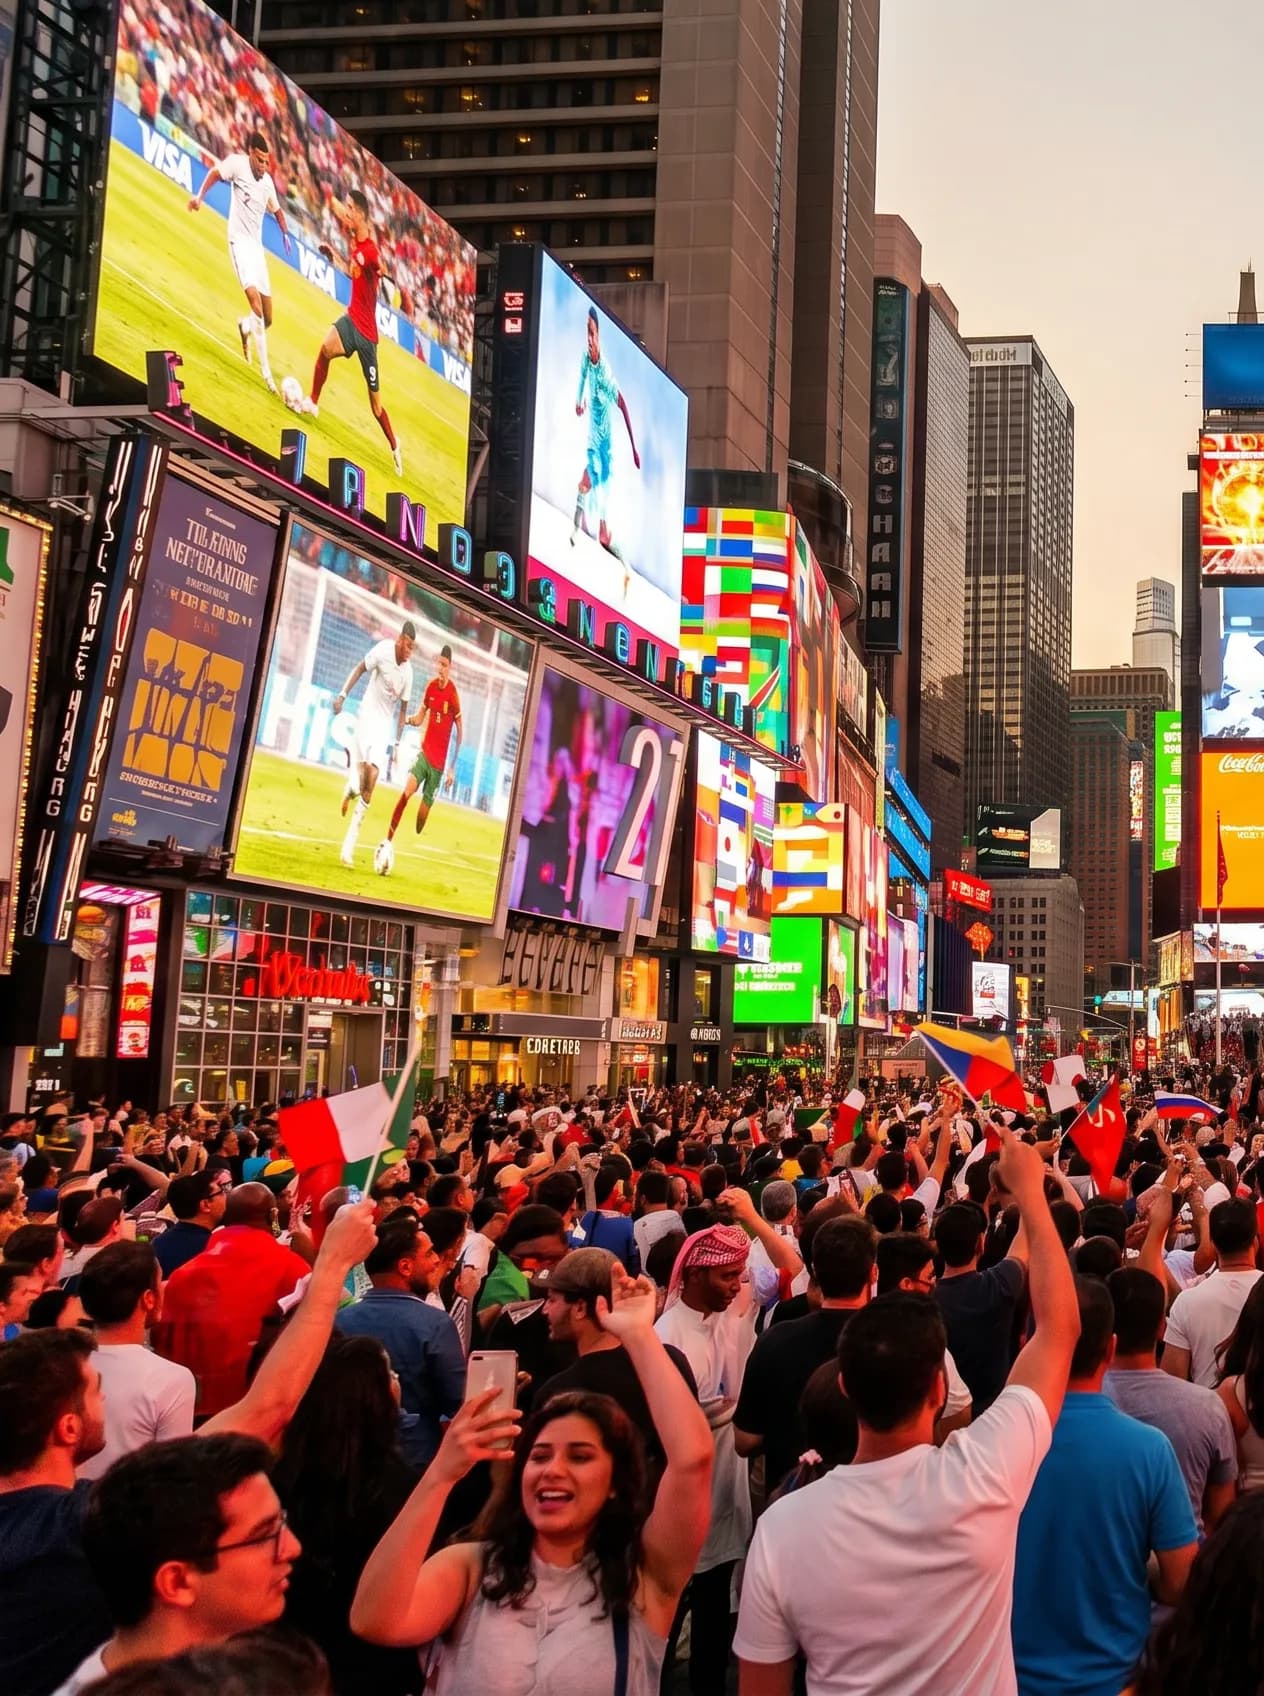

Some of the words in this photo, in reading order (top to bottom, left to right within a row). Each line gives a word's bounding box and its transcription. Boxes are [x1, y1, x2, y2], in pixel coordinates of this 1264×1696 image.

[138, 118, 193, 193] VISA
[295, 240, 337, 302] VISA
[375, 302, 399, 344] ISA
[369, 366, 377, 381] 9
[442, 349, 472, 397] VISA
[604, 725, 684, 887] 21
